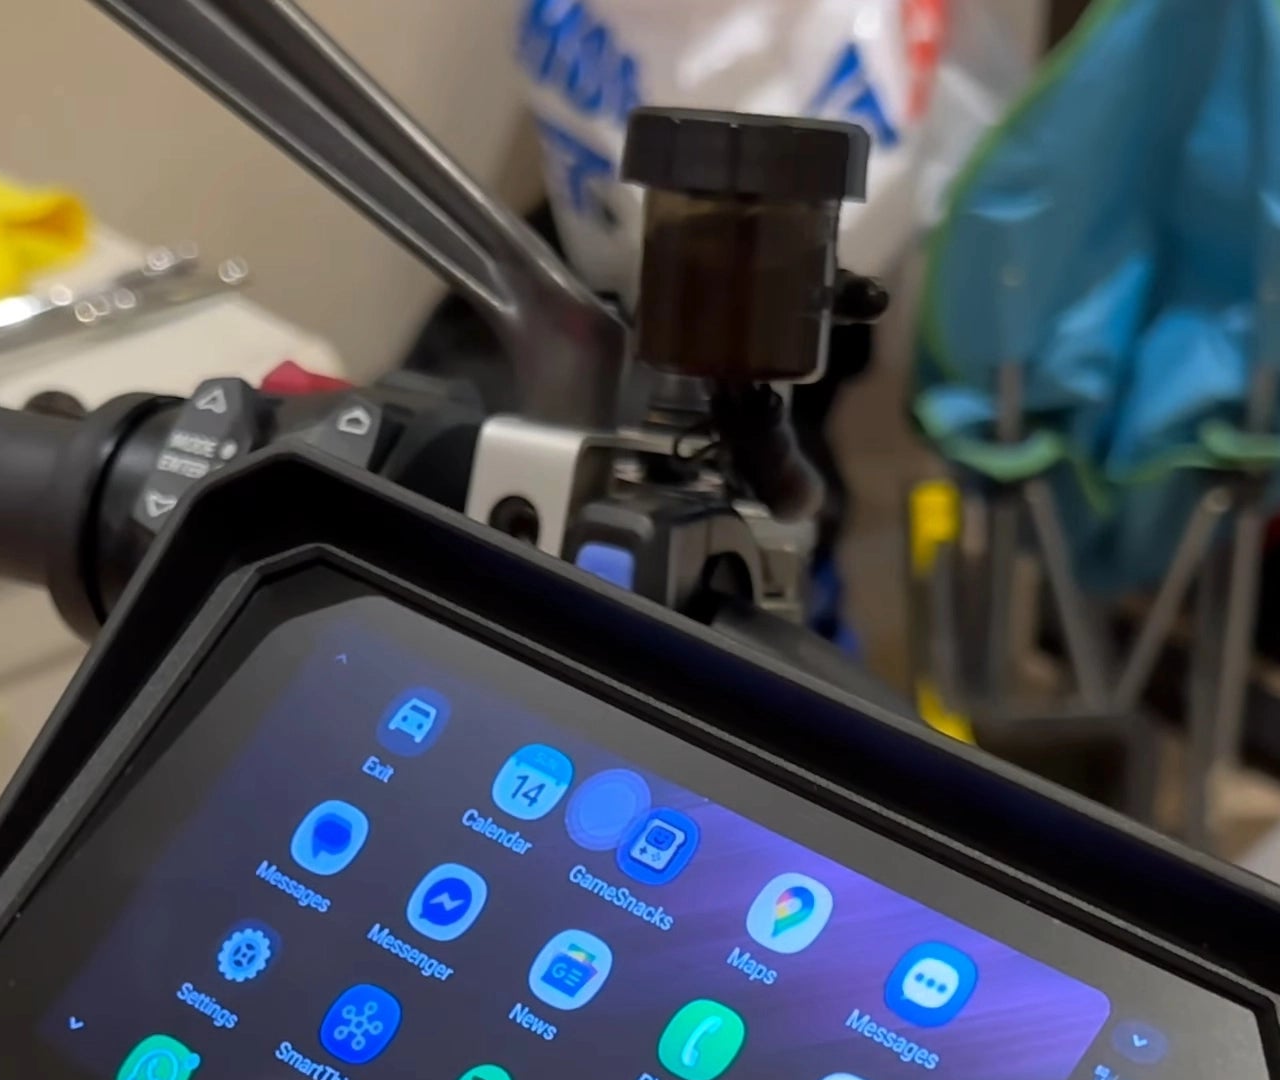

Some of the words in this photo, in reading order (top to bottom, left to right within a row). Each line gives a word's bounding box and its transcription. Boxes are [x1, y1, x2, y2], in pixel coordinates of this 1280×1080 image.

[362, 755, 395, 784] Exit
[511, 774, 546, 808] 14
[461, 808, 533, 856] Calendar
[255, 859, 332, 914] Messages
[568, 863, 675, 931] GameSnacks
[367, 922, 455, 982] Messenger
[727, 946, 779, 986] Maps
[176, 981, 239, 1030] Settings
[508, 1002, 558, 1041] News
[845, 1008, 940, 1071] Messages
